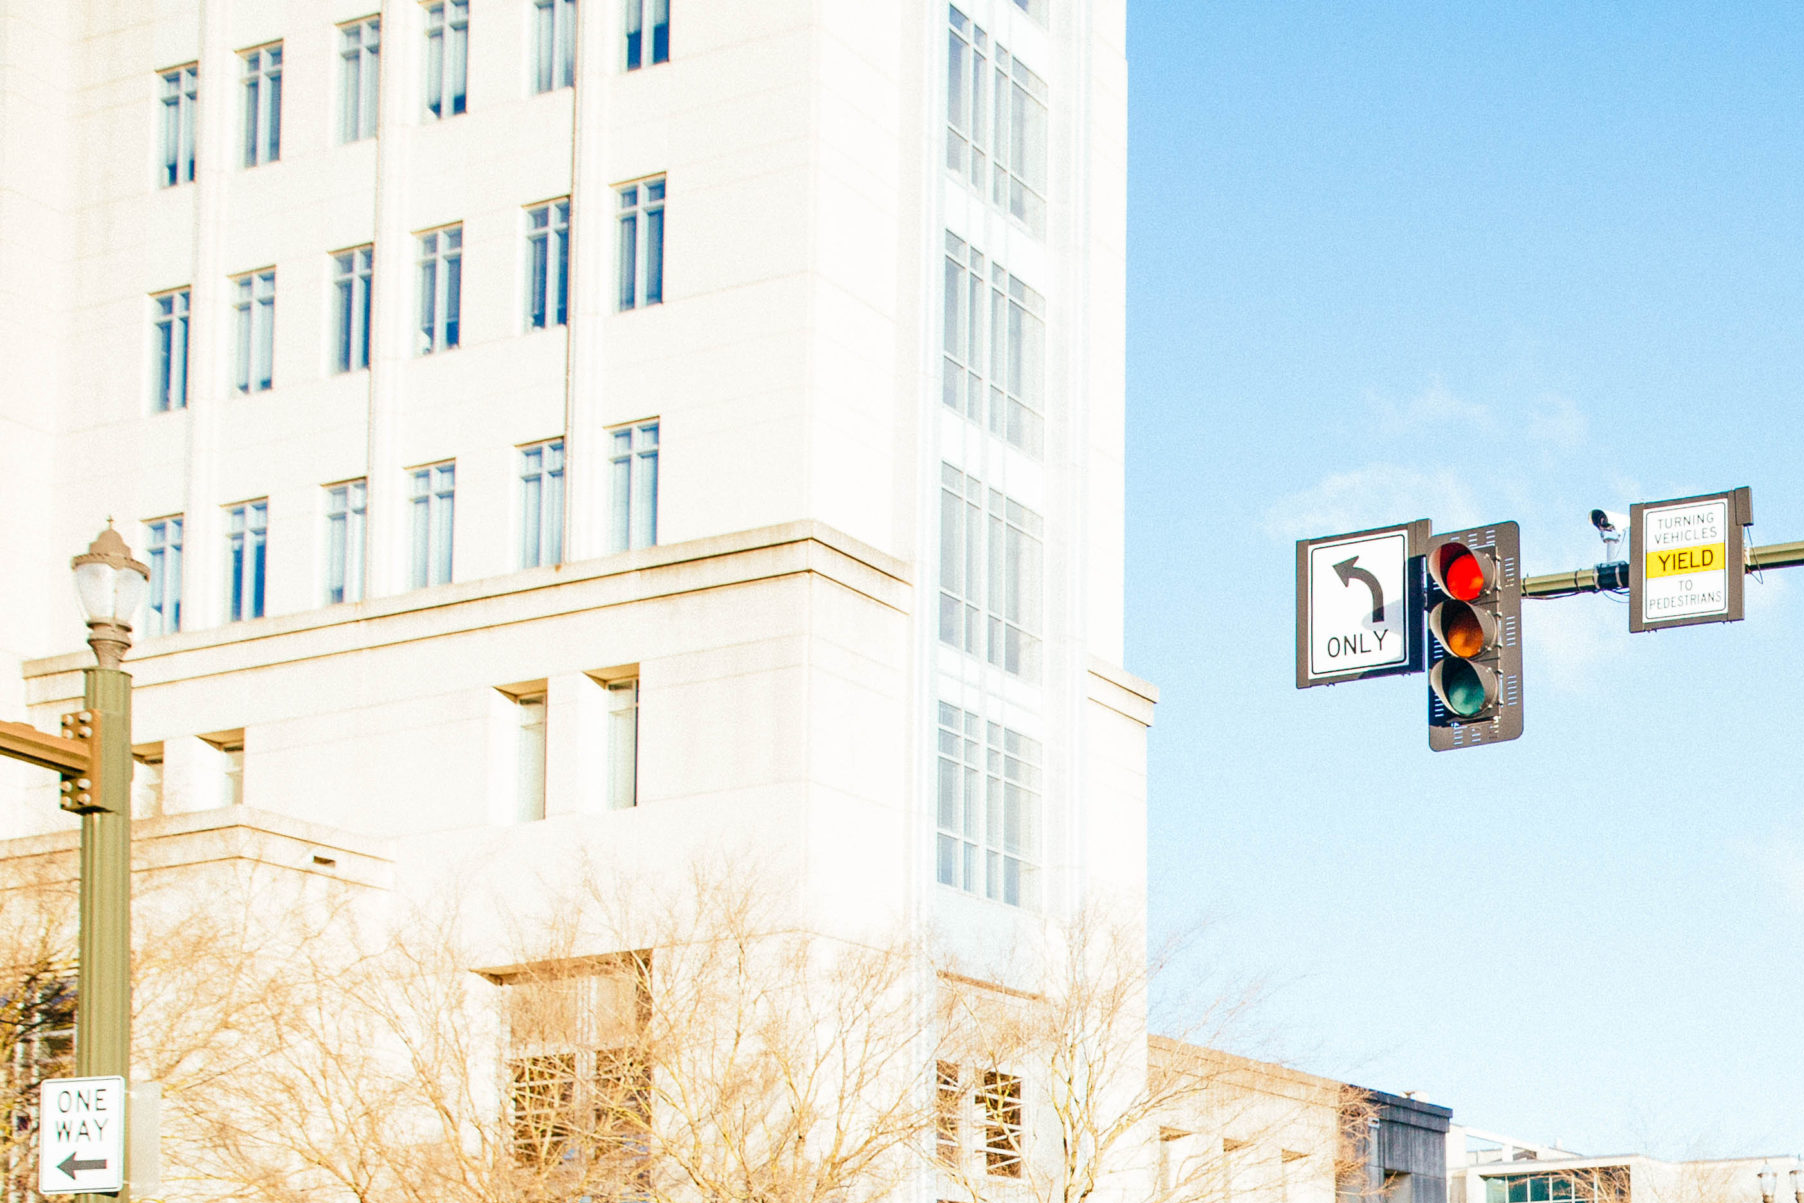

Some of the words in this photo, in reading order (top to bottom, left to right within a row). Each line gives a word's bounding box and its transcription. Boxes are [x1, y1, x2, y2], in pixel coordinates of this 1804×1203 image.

[1658, 512, 1715, 530] TURNING
[1654, 527, 1718, 545] VEHICLES
[1658, 549, 1714, 572] YIELD
[1679, 579, 1693, 591] TO
[1649, 591, 1722, 610] PEDESTRIANS
[1327, 629, 1389, 658] ONLY
[57, 1088, 107, 1113] ONE
[55, 1118, 109, 1143] WAY
